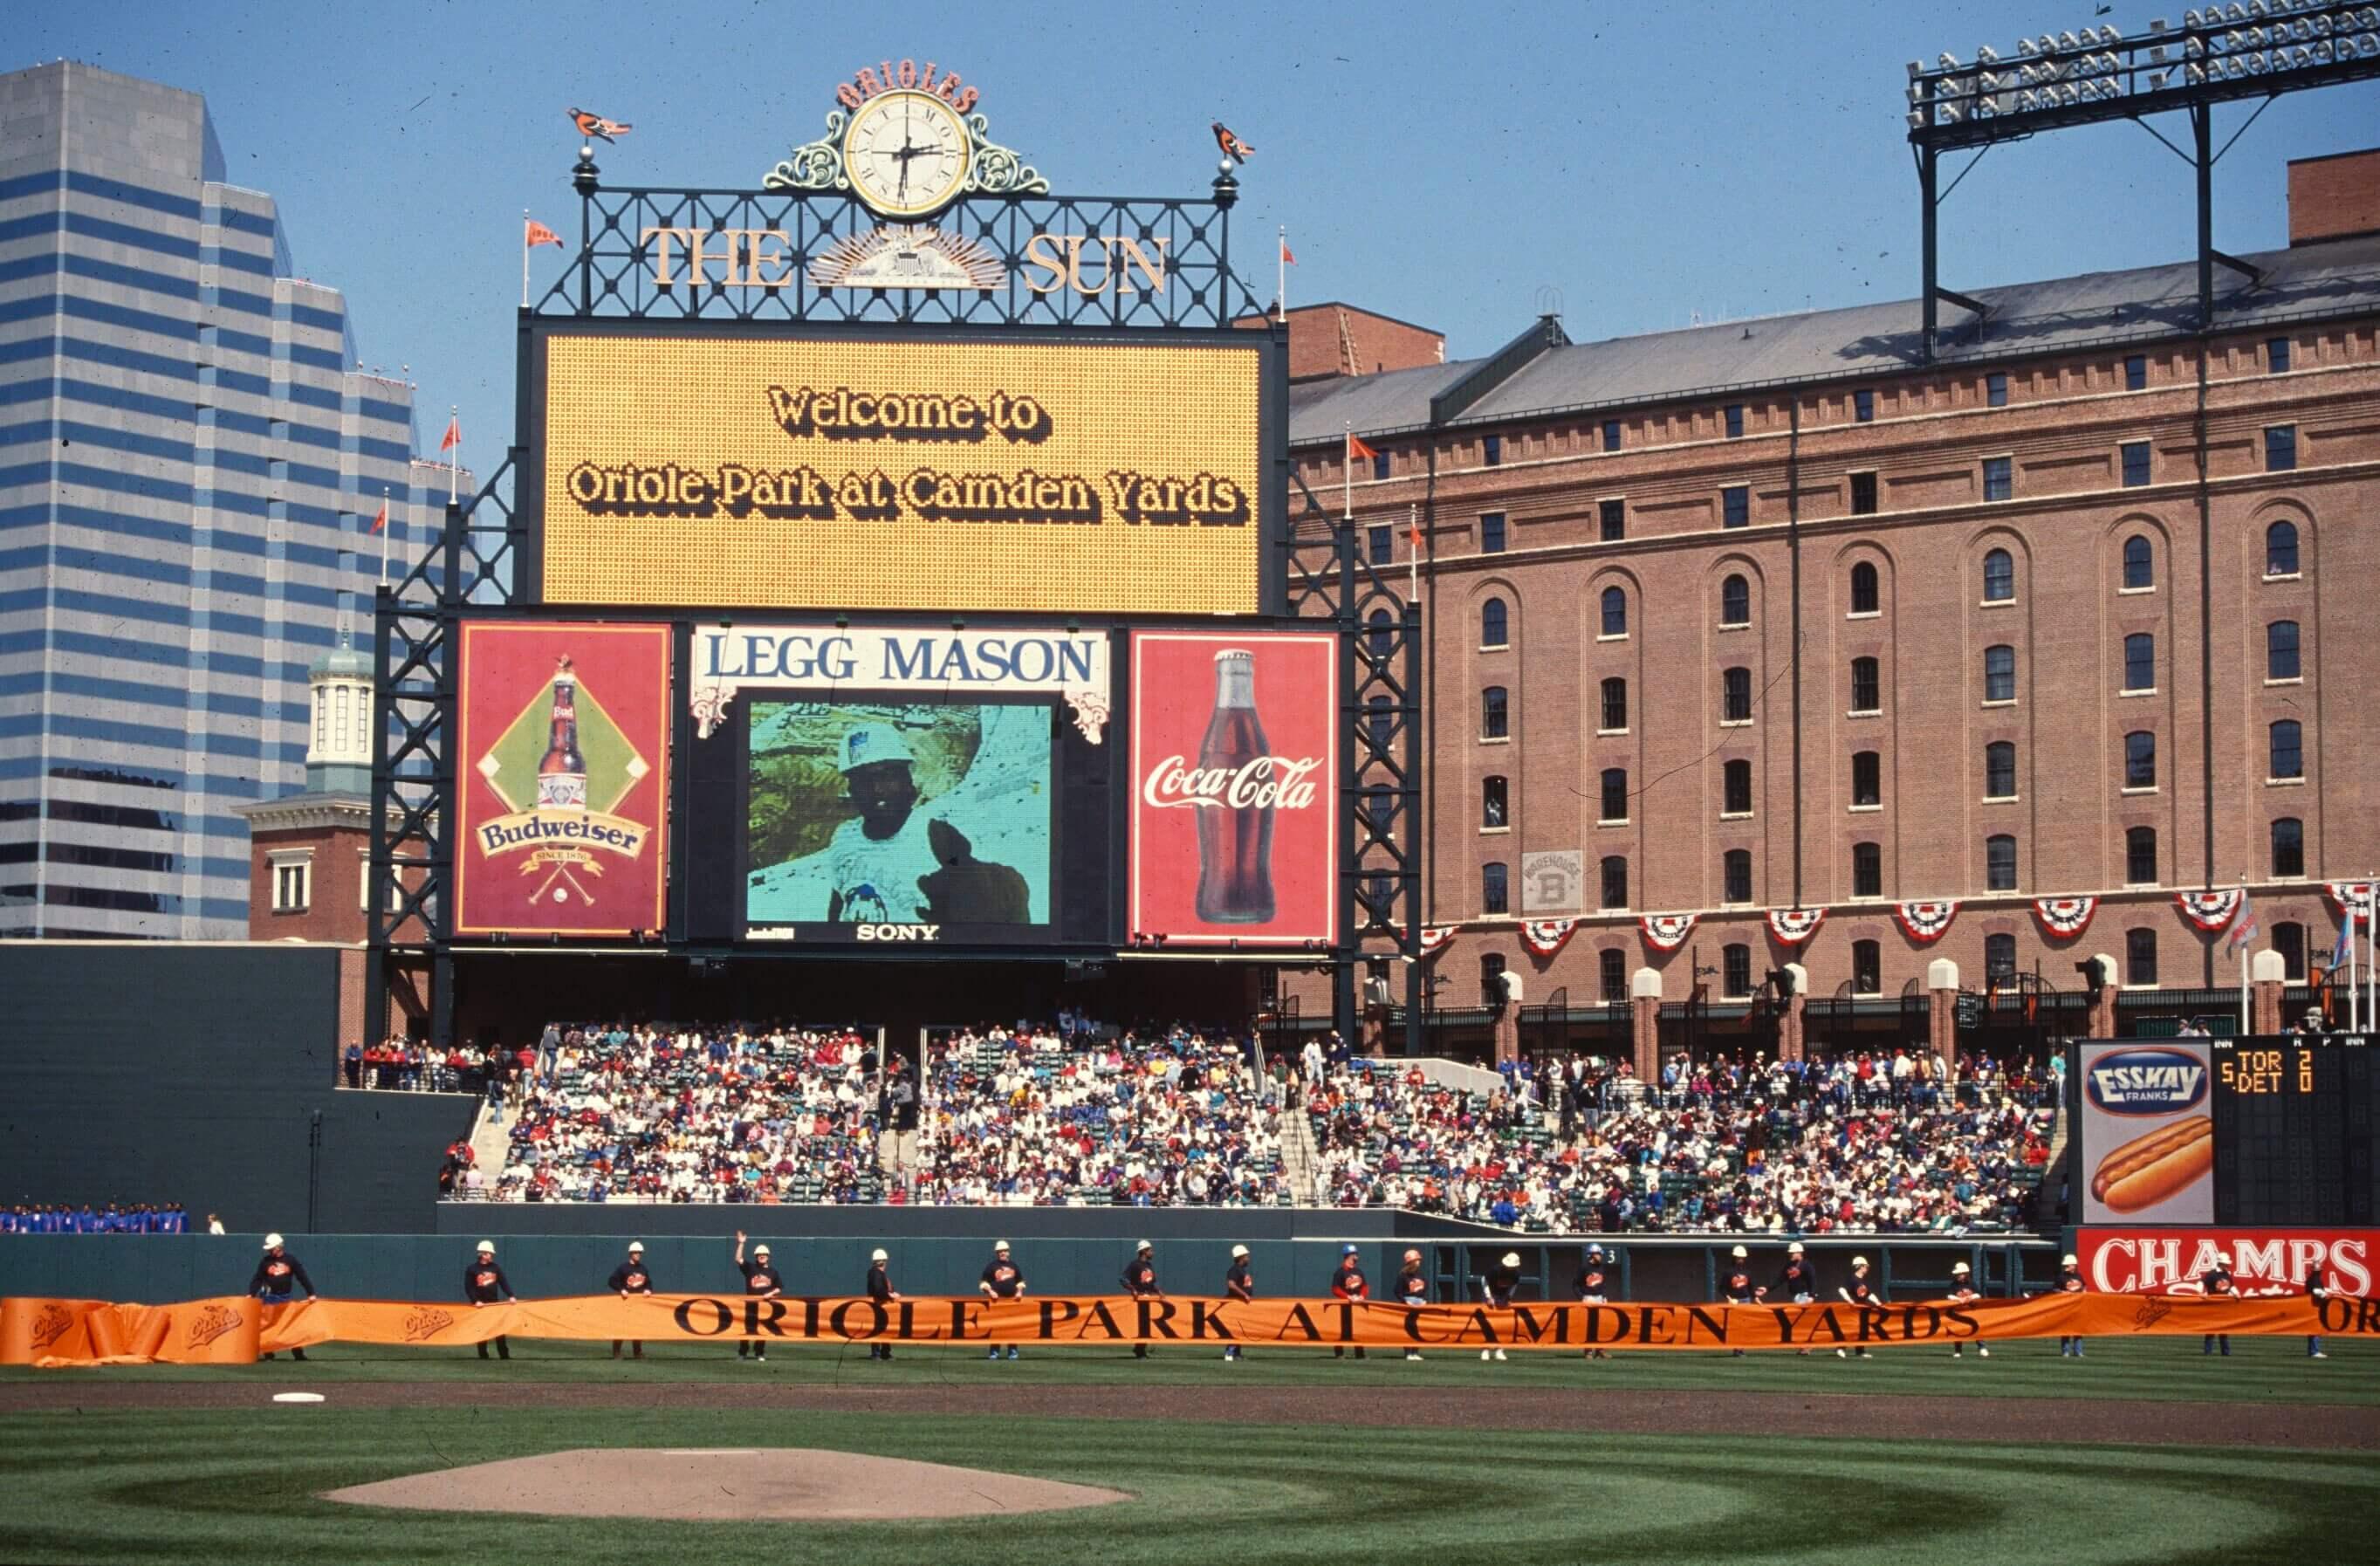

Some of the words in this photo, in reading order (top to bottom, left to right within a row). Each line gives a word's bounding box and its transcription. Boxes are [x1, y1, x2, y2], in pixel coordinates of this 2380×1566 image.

[837, 58, 980, 112] ORIOLES
[641, 227, 791, 287] THE
[1024, 233, 1169, 295] SUN
[767, 385, 986, 443] Welcome
[987, 390, 1053, 443] to
[566, 461, 718, 517] Oriole
[718, 463, 835, 519] Park
[837, 468, 899, 519] at
[901, 466, 1102, 523] Camden
[1106, 470, 1252, 525] Yards
[703, 635, 859, 678] LEGG
[879, 637, 1097, 683] MASON
[553, 705, 573, 718] Bud
[1144, 754, 1325, 809] Coca-Cola
[482, 816, 638, 850] Budweiser
[537, 851, 562, 860] SINCE
[566, 852, 587, 861] 1876
[1537, 873, 1566, 904] B
[857, 923, 936, 941] SONY
[2214, 1039, 2233, 1048] INN
[2346, 1037, 2366, 1046] INN
[2237, 1051, 2283, 1072] TOR
[2298, 1050, 2312, 1071] 2
[2092, 1066, 2204, 1102] ESSKAY
[2125, 1091, 2170, 1101] FRANKS
[2237, 1072, 2283, 1093] DET
[2299, 1071, 2312, 1092] 0
[1607, 1249, 1615, 1264] 3
[2092, 1238, 2371, 1298] CHAMPS
[675, 1297, 991, 1339] ORIOLE
[1037, 1300, 1233, 1340] PARK
[1277, 1302, 1369, 1342] AT
[1403, 1308, 1729, 1344] CAMDEN
[1771, 1307, 1979, 1343] YARDS
